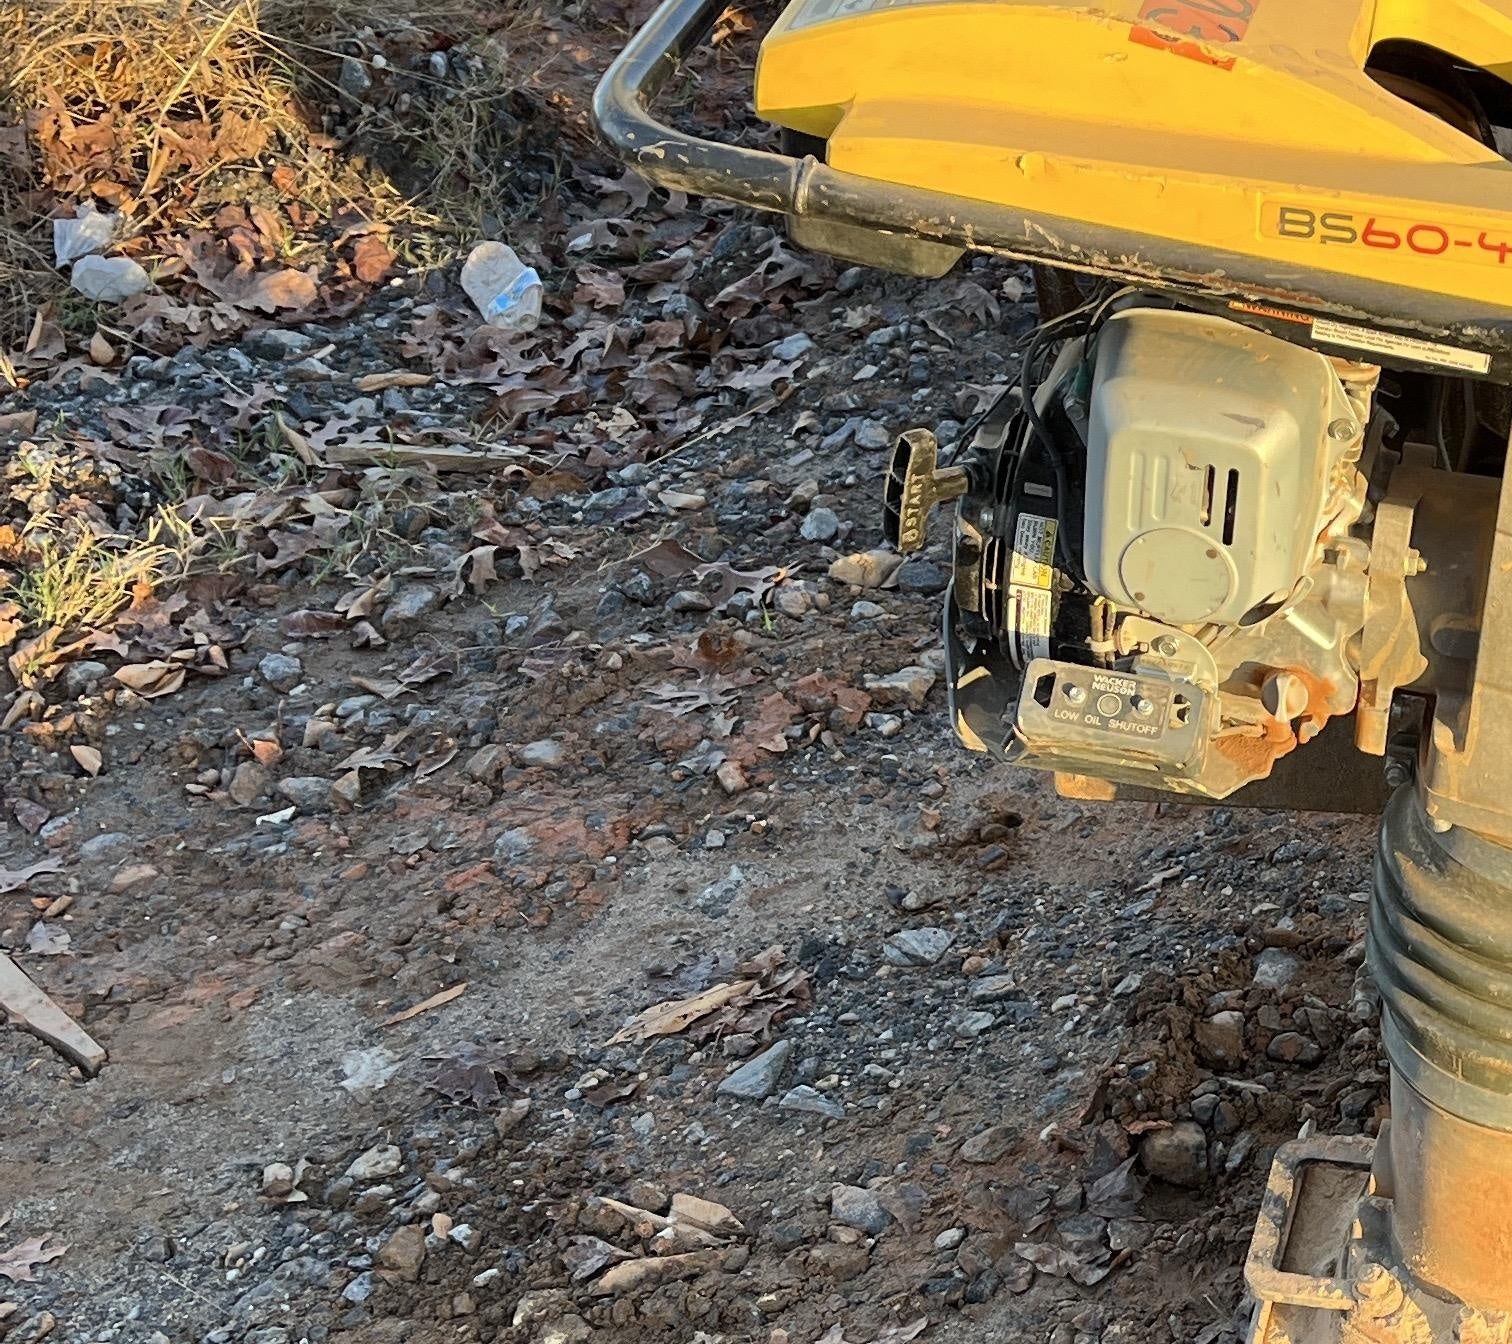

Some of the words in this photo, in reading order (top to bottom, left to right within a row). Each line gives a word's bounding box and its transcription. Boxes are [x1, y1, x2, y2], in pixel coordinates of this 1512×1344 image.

[1092, 681, 1136, 696] NEUSON
[1093, 674, 1137, 688] WACKER
[1054, 708, 1080, 722] LOW
[1084, 714, 1101, 726] OIL
[1108, 719, 1159, 735] SHUTOFF
